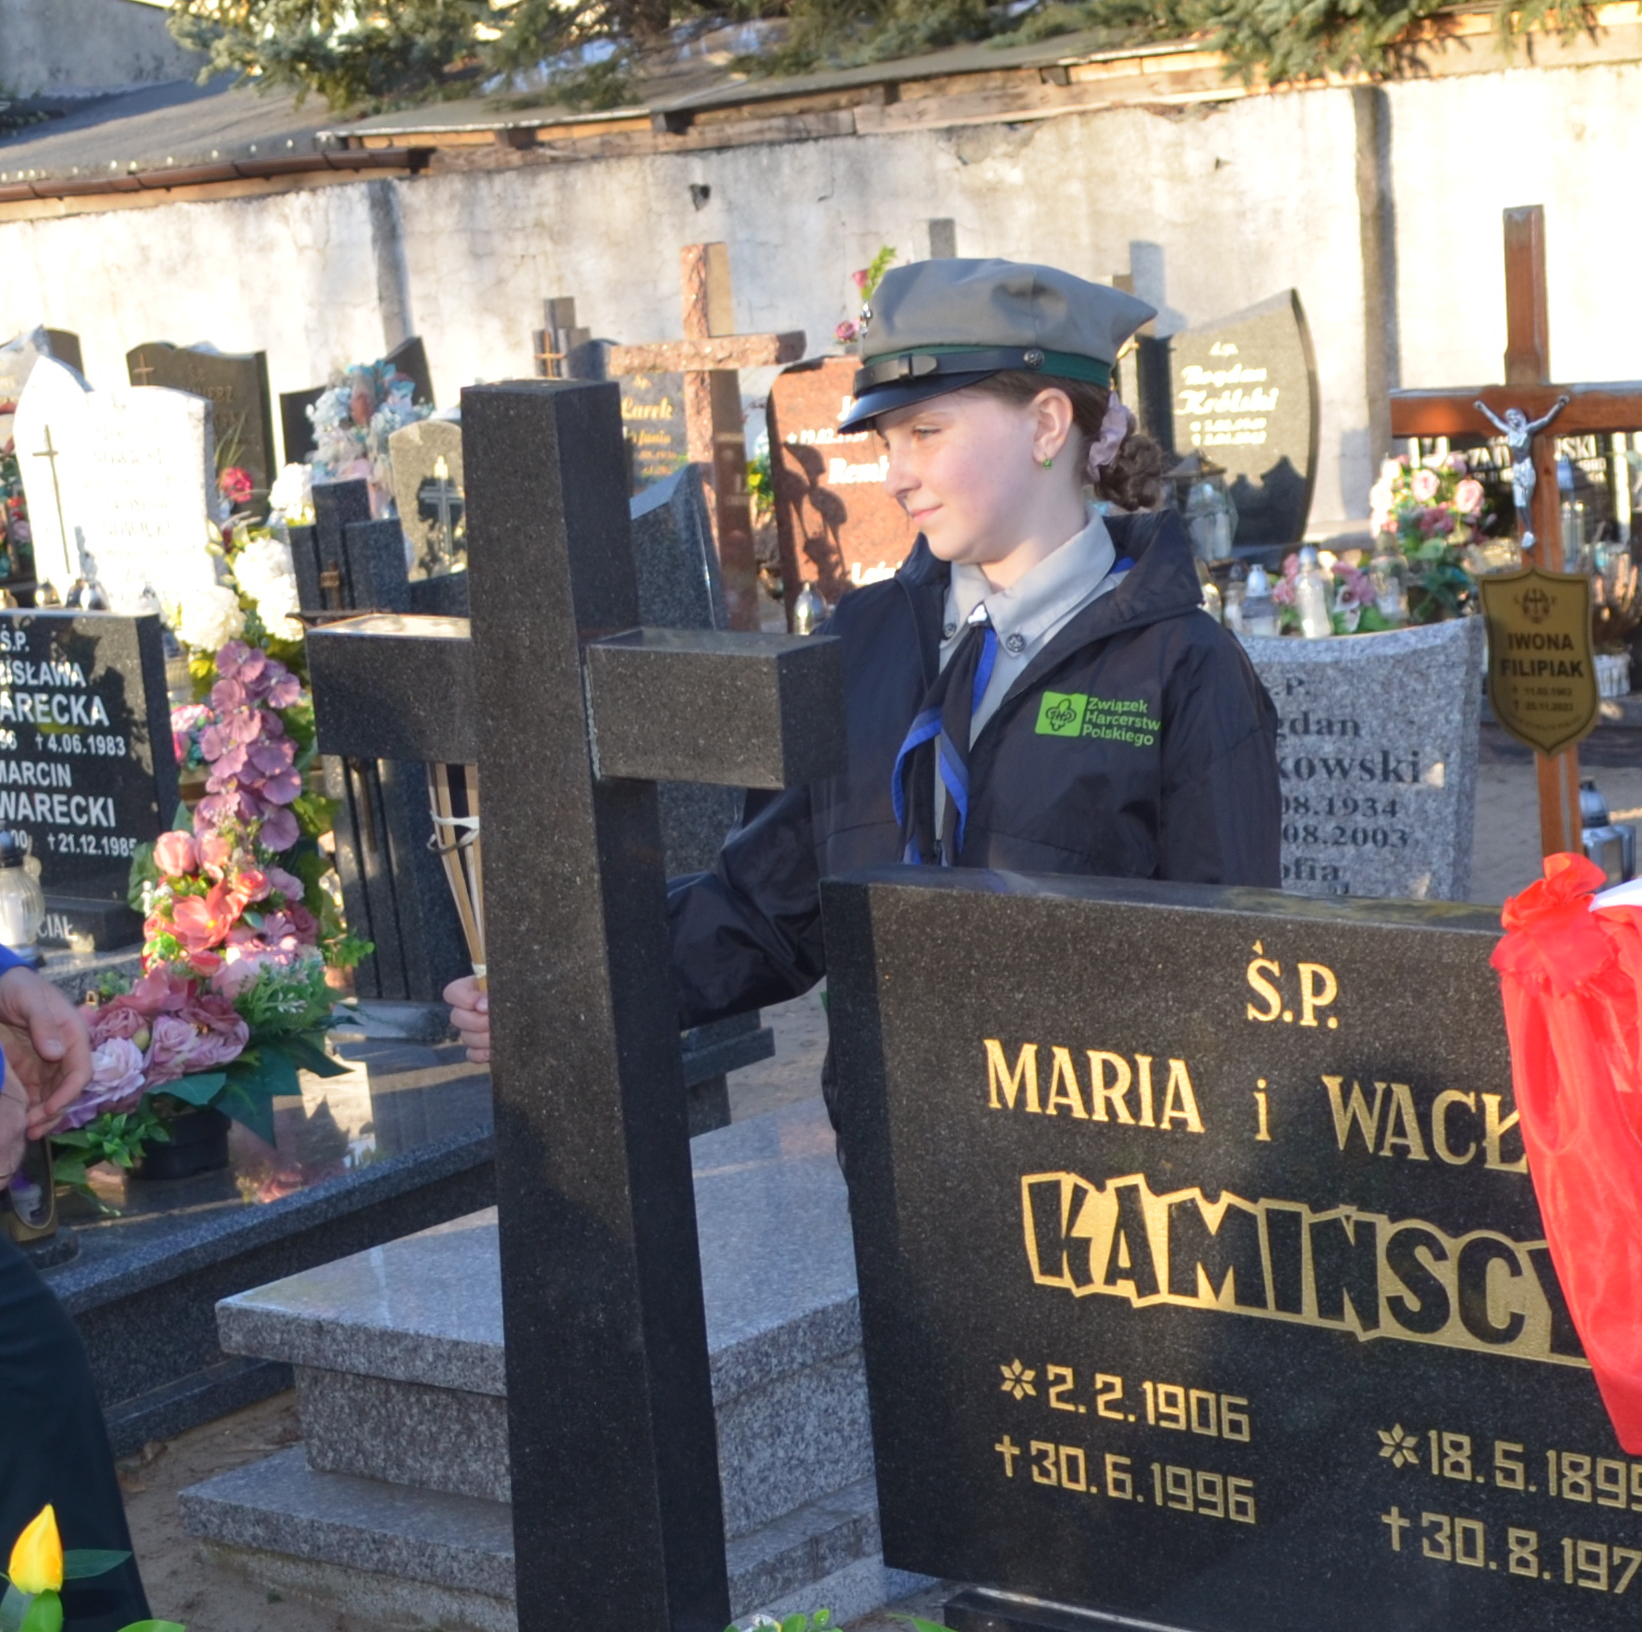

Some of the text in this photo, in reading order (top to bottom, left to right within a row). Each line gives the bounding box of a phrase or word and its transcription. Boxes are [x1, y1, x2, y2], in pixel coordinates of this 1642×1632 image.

[1508, 632, 1575, 651] IWONA
[1500, 659, 1584, 678] FILIPIAK
[1087, 697, 1149, 714] Związek
[47, 732, 126, 757] 4.06.1983
[1082, 723, 1155, 747] Polskiego
[1245, 940, 1339, 1029] Ś.P.
[982, 1037, 1206, 1134] MARIA
[1252, 1078, 1272, 1141] i
[1045, 1362, 1251, 1443] 2.2.1906
[1029, 1438, 1256, 1525] 30.6.1996
